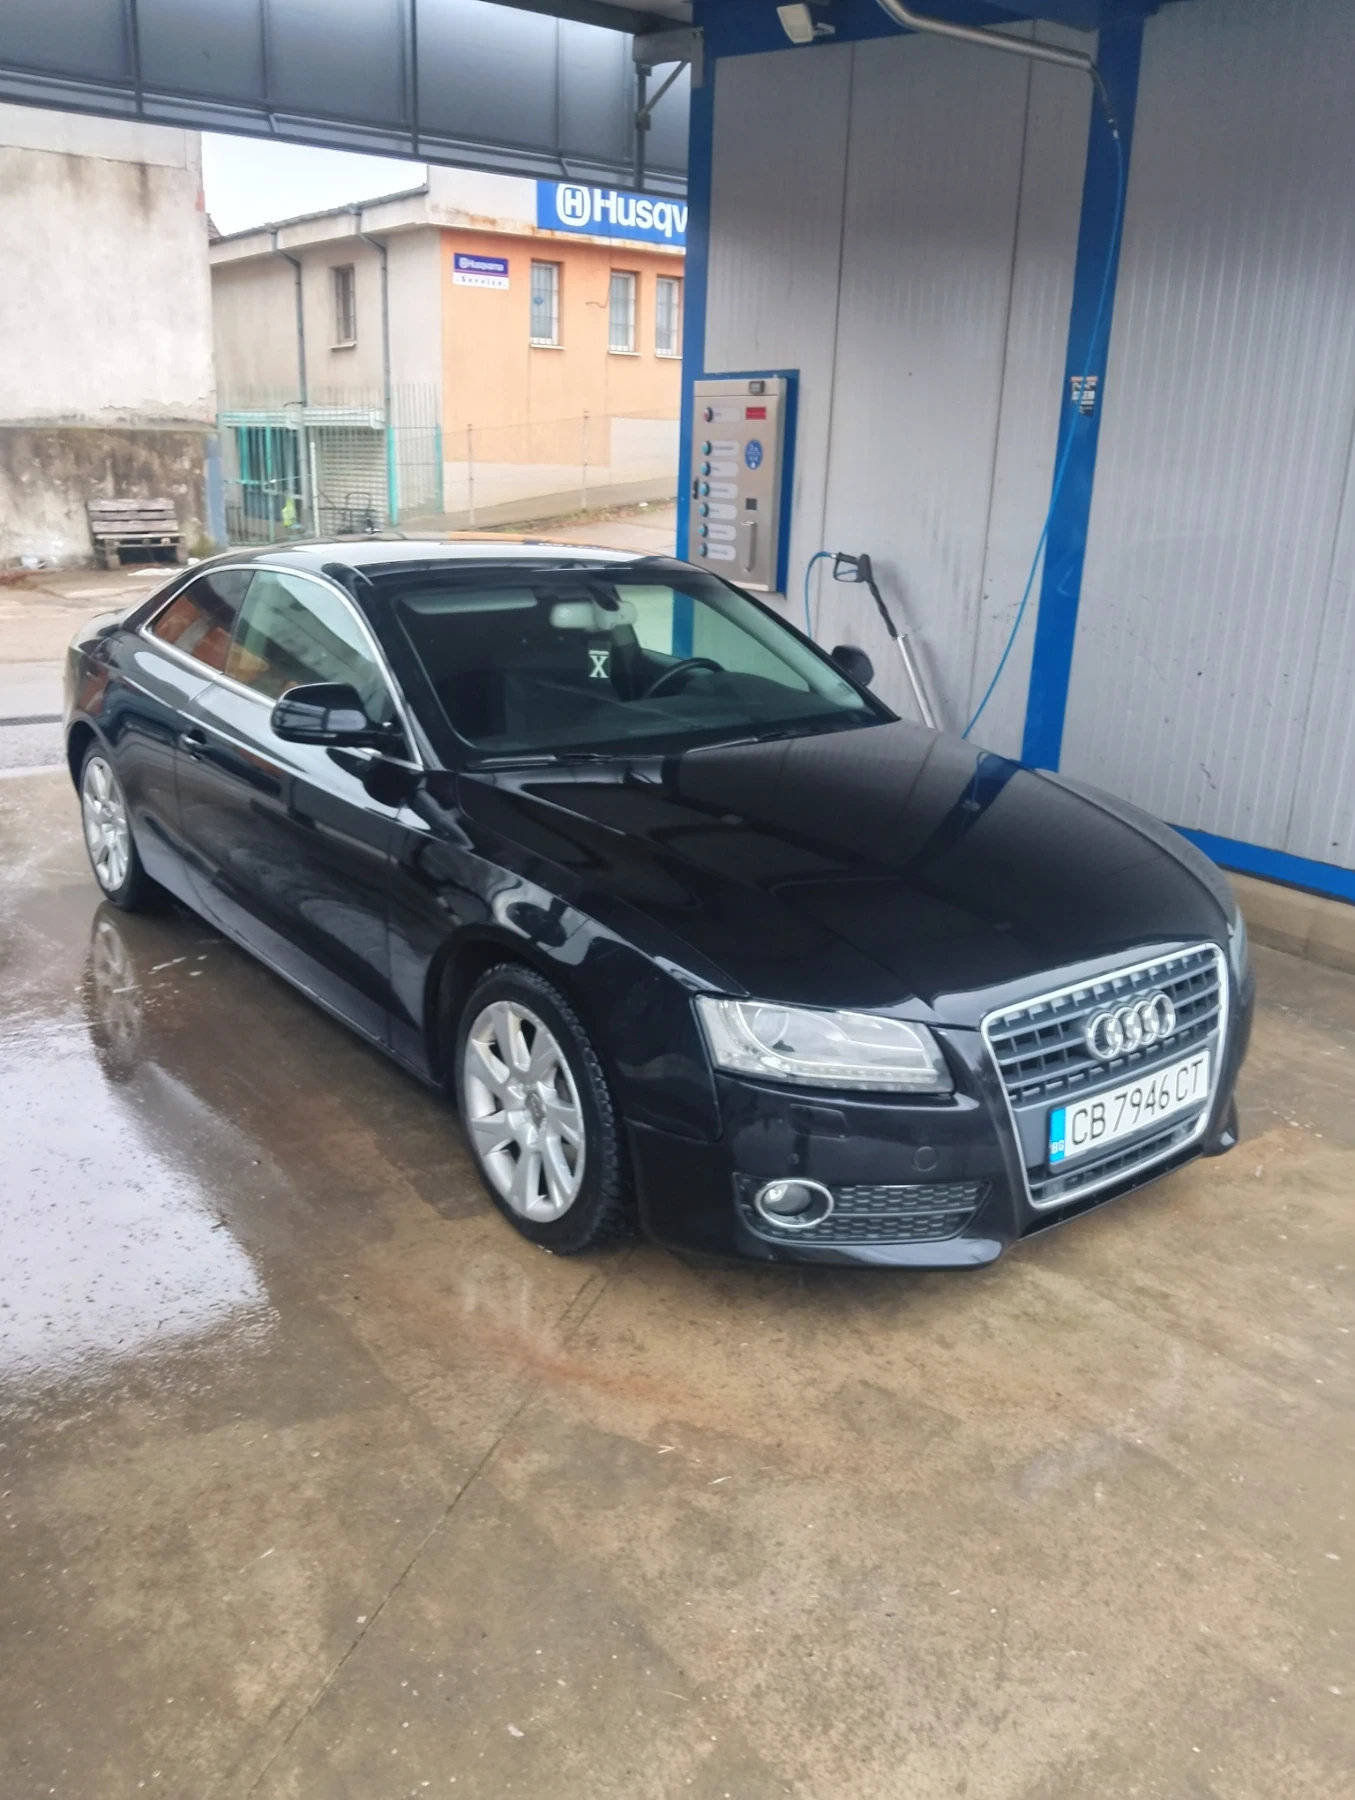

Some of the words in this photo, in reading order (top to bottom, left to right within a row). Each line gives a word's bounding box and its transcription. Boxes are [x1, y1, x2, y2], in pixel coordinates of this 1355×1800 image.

[593, 188, 688, 238] Husqv
[461, 275, 502, 287] Service
[1071, 1102, 1107, 1146] CB
[1113, 1074, 1171, 1133] 7946
[1175, 1058, 1204, 1103] CT
[1051, 1140, 1065, 1154] BG
